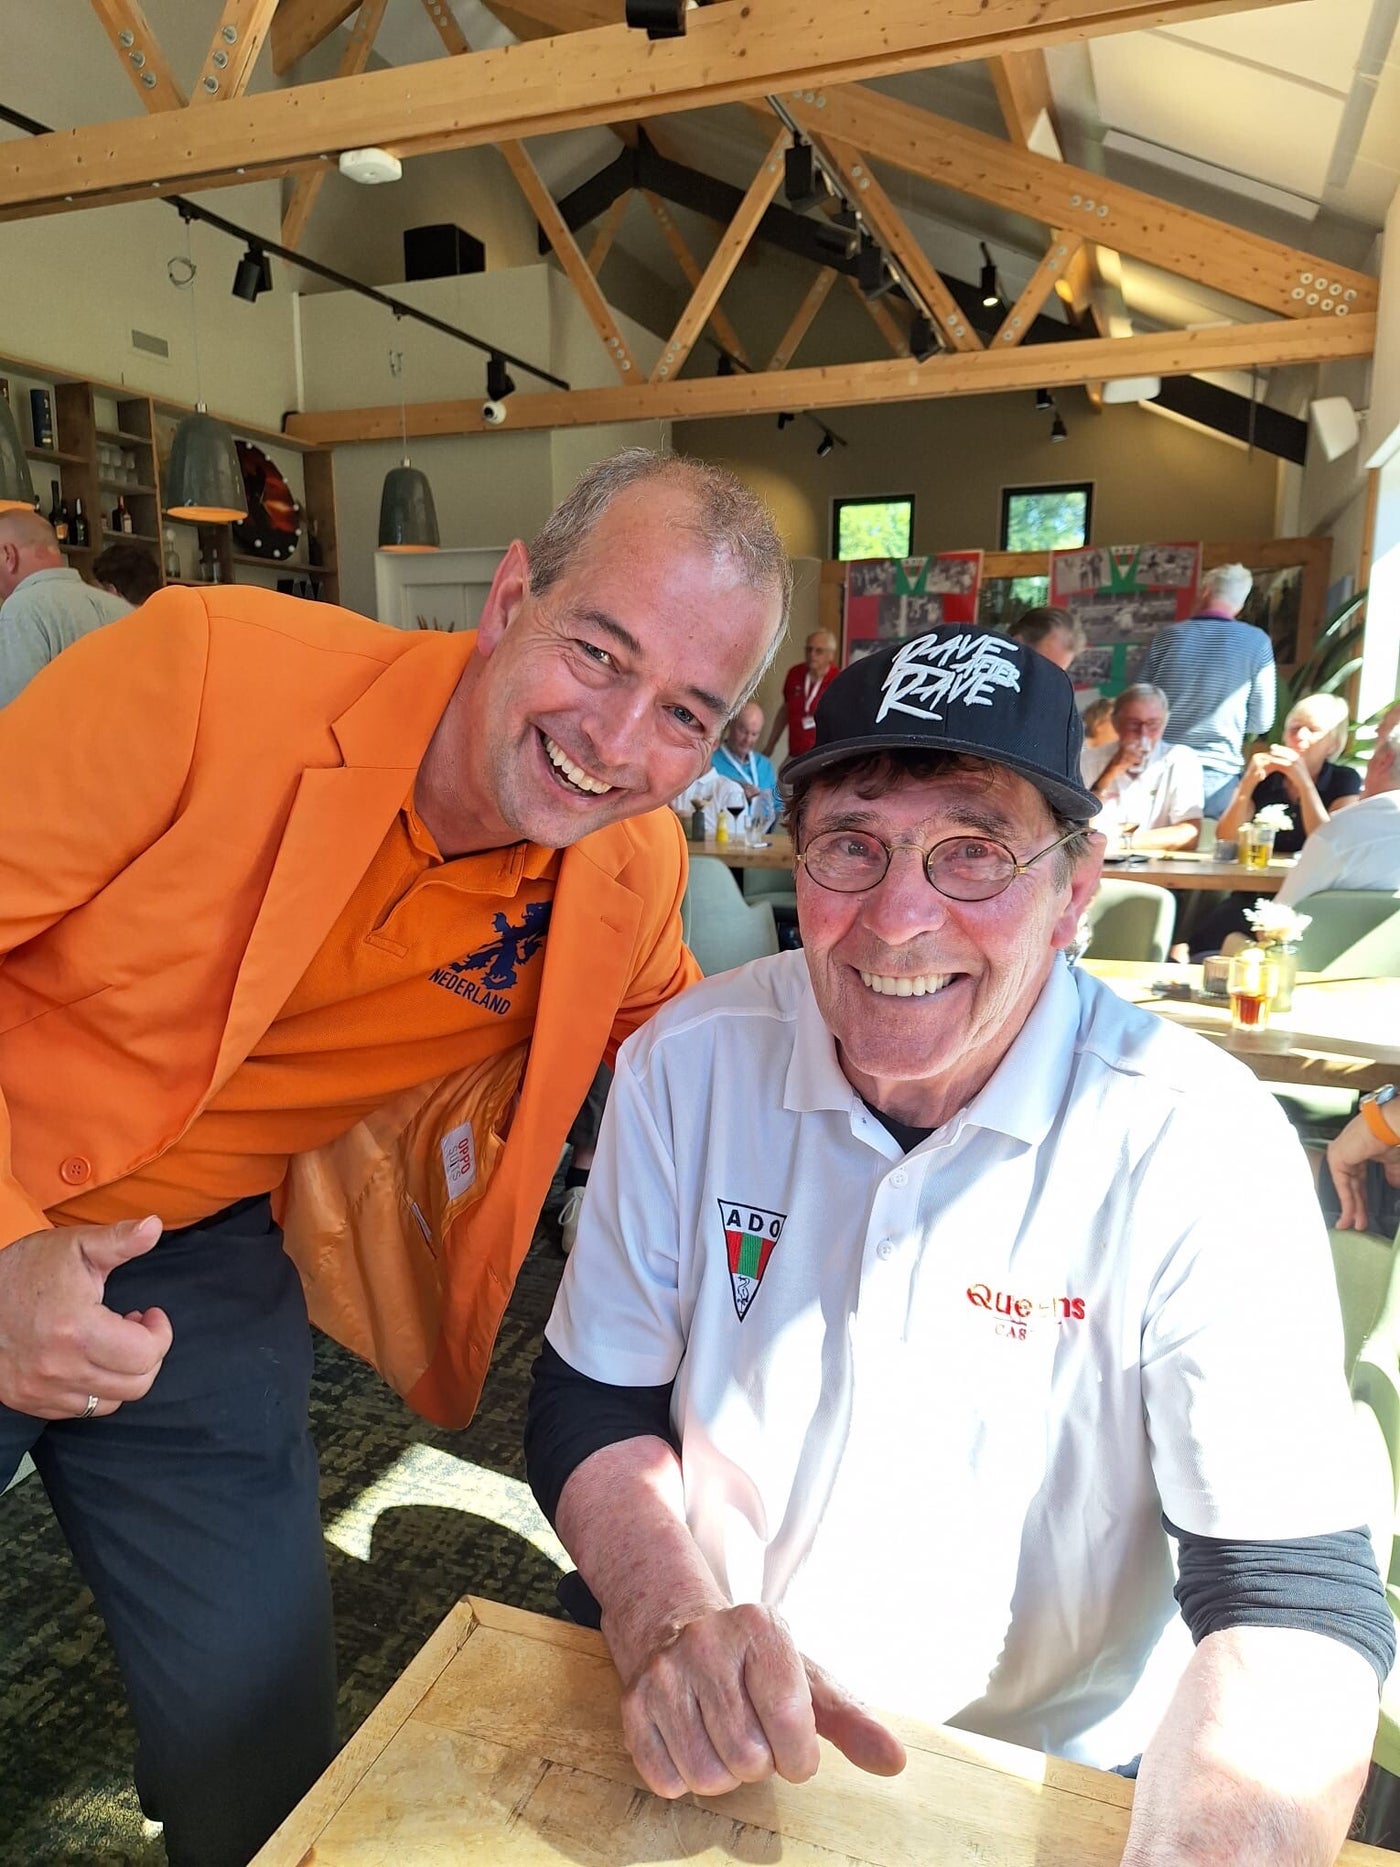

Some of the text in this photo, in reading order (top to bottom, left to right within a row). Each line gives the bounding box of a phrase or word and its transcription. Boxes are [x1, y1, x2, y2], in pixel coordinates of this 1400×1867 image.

[881, 633, 1019, 690] RAVE
[876, 667, 996, 723] RAVE
[428, 968, 512, 1015] NEDERLAND
[458, 1138, 471, 1175] OPPO
[726, 1209, 781, 1239] ADO
